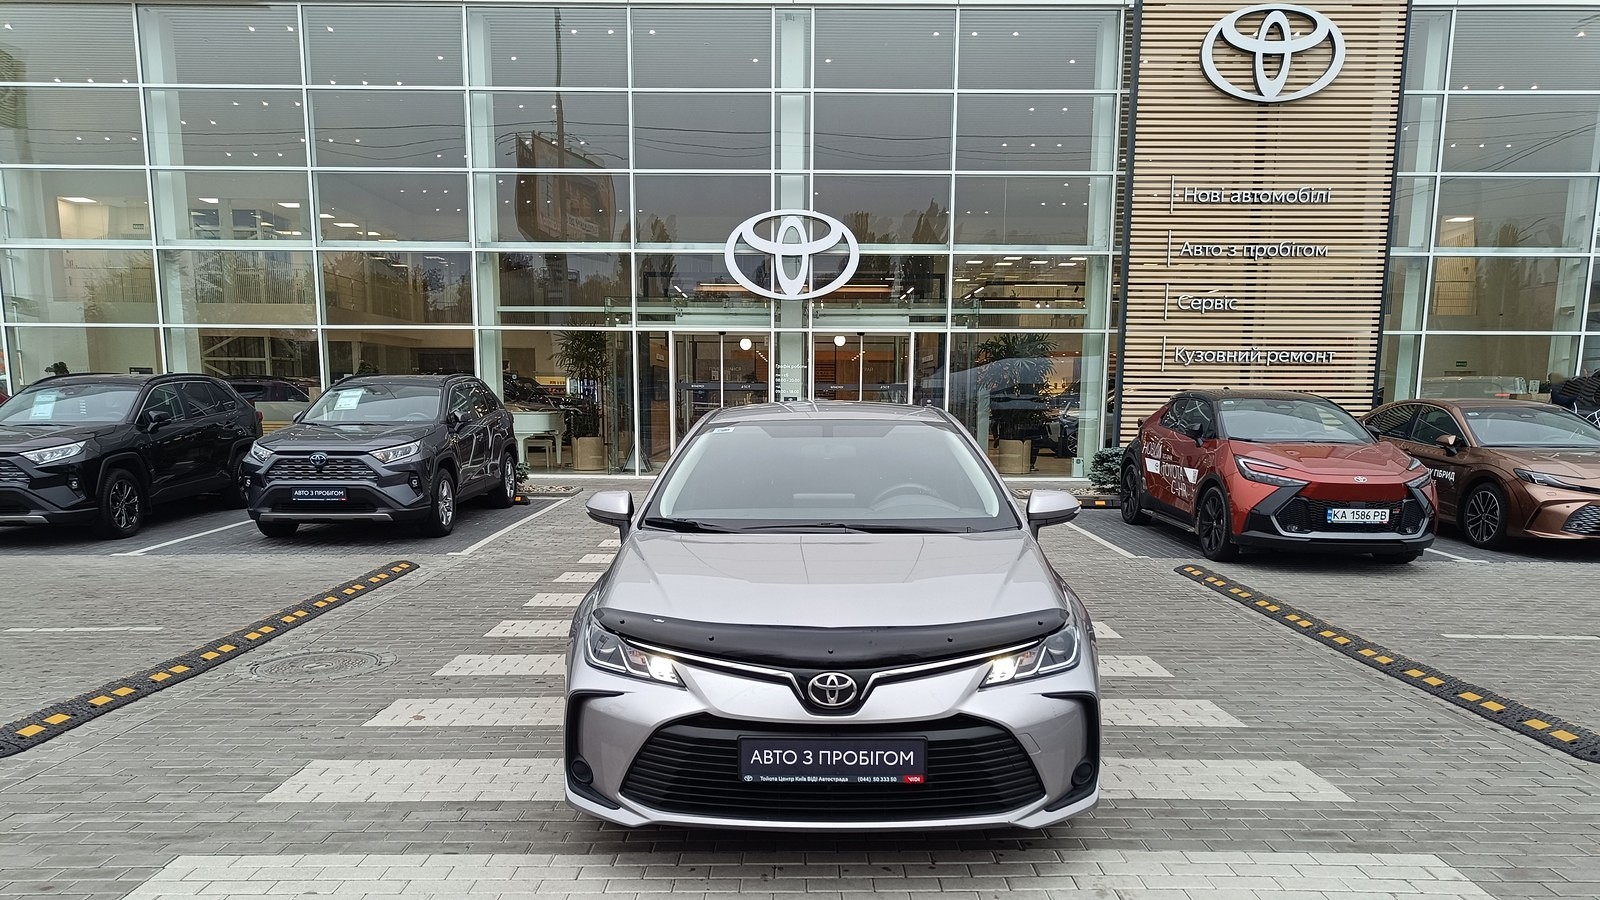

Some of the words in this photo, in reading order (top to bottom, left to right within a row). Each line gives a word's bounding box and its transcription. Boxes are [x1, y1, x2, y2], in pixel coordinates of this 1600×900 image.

[1183, 186, 1226, 203] Нові
[1230, 186, 1333, 203] автомобілі
[1179, 241, 1223, 257] Авто
[1227, 244, 1237, 257] з
[1243, 241, 1329, 261] пробігом
[1177, 294, 1240, 314] Сервіс
[1174, 346, 1261, 366] Кузовний
[1265, 351, 1336, 367] ремонт
[1433, 469, 1456, 482] ГІБРИД
[1350, 510, 1371, 520] 1586
[750, 750, 798, 765] АВТО
[819, 750, 914, 766] ПРОБІГОМ
